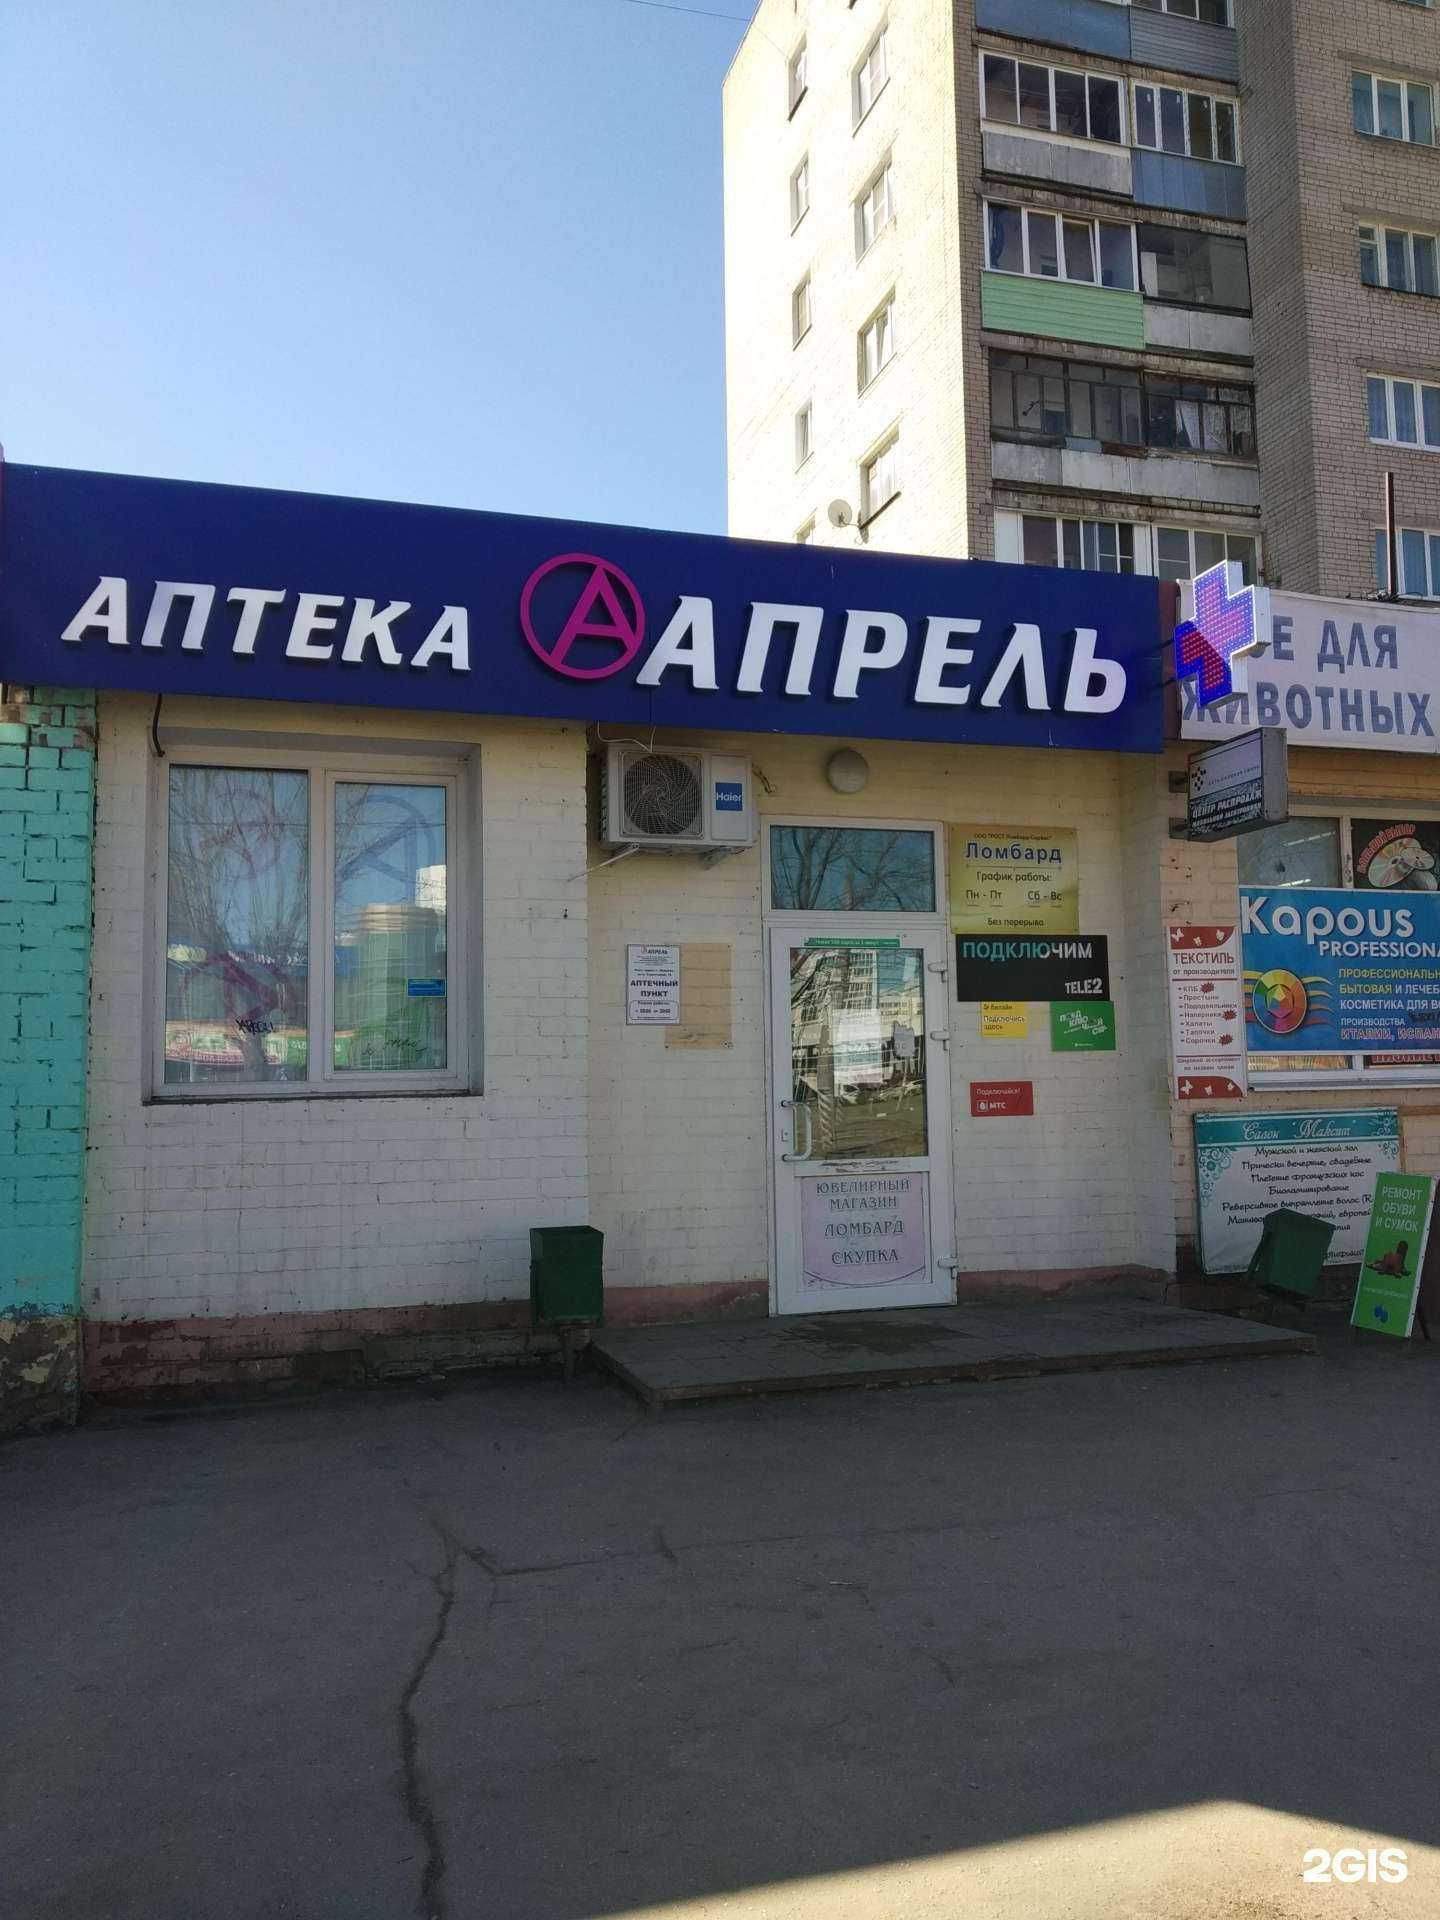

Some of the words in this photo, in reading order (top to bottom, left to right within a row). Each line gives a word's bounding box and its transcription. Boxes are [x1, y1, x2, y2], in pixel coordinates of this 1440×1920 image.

[60, 575, 472, 671] АПТЕКА
[635, 595, 1128, 714] АПРЕЛЬ
[1317, 619, 1399, 674] ДЛЯ
[716, 792, 742, 802] Haier
[965, 842, 1062, 864] Ломбард
[976, 871, 1013, 883] График
[966, 889, 980, 899] Пн
[990, 890, 1003, 899] Пт
[1027, 890, 1041, 901] Сб
[1050, 891, 1062, 901] Вс
[987, 917, 1002, 926] Без
[1240, 895, 1415, 944] Kapous
[962, 941, 1093, 961] ПОДКЛЮЧИМ
[1173, 952, 1235, 965] ТЕКСТИЛЬ
[1064, 977, 1103, 994] TELE2
[1339, 984, 1392, 994] БЫТОВАЯ
[1395, 984, 1402, 994] И
[1340, 999, 1404, 1010] КОСМЕТИКА
[1406, 999, 1428, 1011] ДЛЯ
[1341, 1017, 1405, 1027] ПРОИЗВОДСТВА
[989, 1102, 1007, 1110] МТС
[1255, 1146, 1297, 1157] Мужской
[1242, 1160, 1285, 1172] Прически
[1329, 1156, 1372, 1168] свадебные
[1251, 1173, 1290, 1184] Плетение
[1350, 1170, 1365, 1178] кос
[816, 1178, 909, 1194] ЮВЕЛИРНЫЙ
[1382, 1186, 1424, 1201] РЕМОНТ
[830, 1196, 897, 1210] МАГАЗИН
[1382, 1201, 1417, 1216] ОБУВИ
[824, 1220, 905, 1237] ЛОМБАРД
[1375, 1218, 1384, 1228] И
[1384, 1218, 1420, 1233] СУМОК
[831, 1249, 899, 1265] СКУПКА
